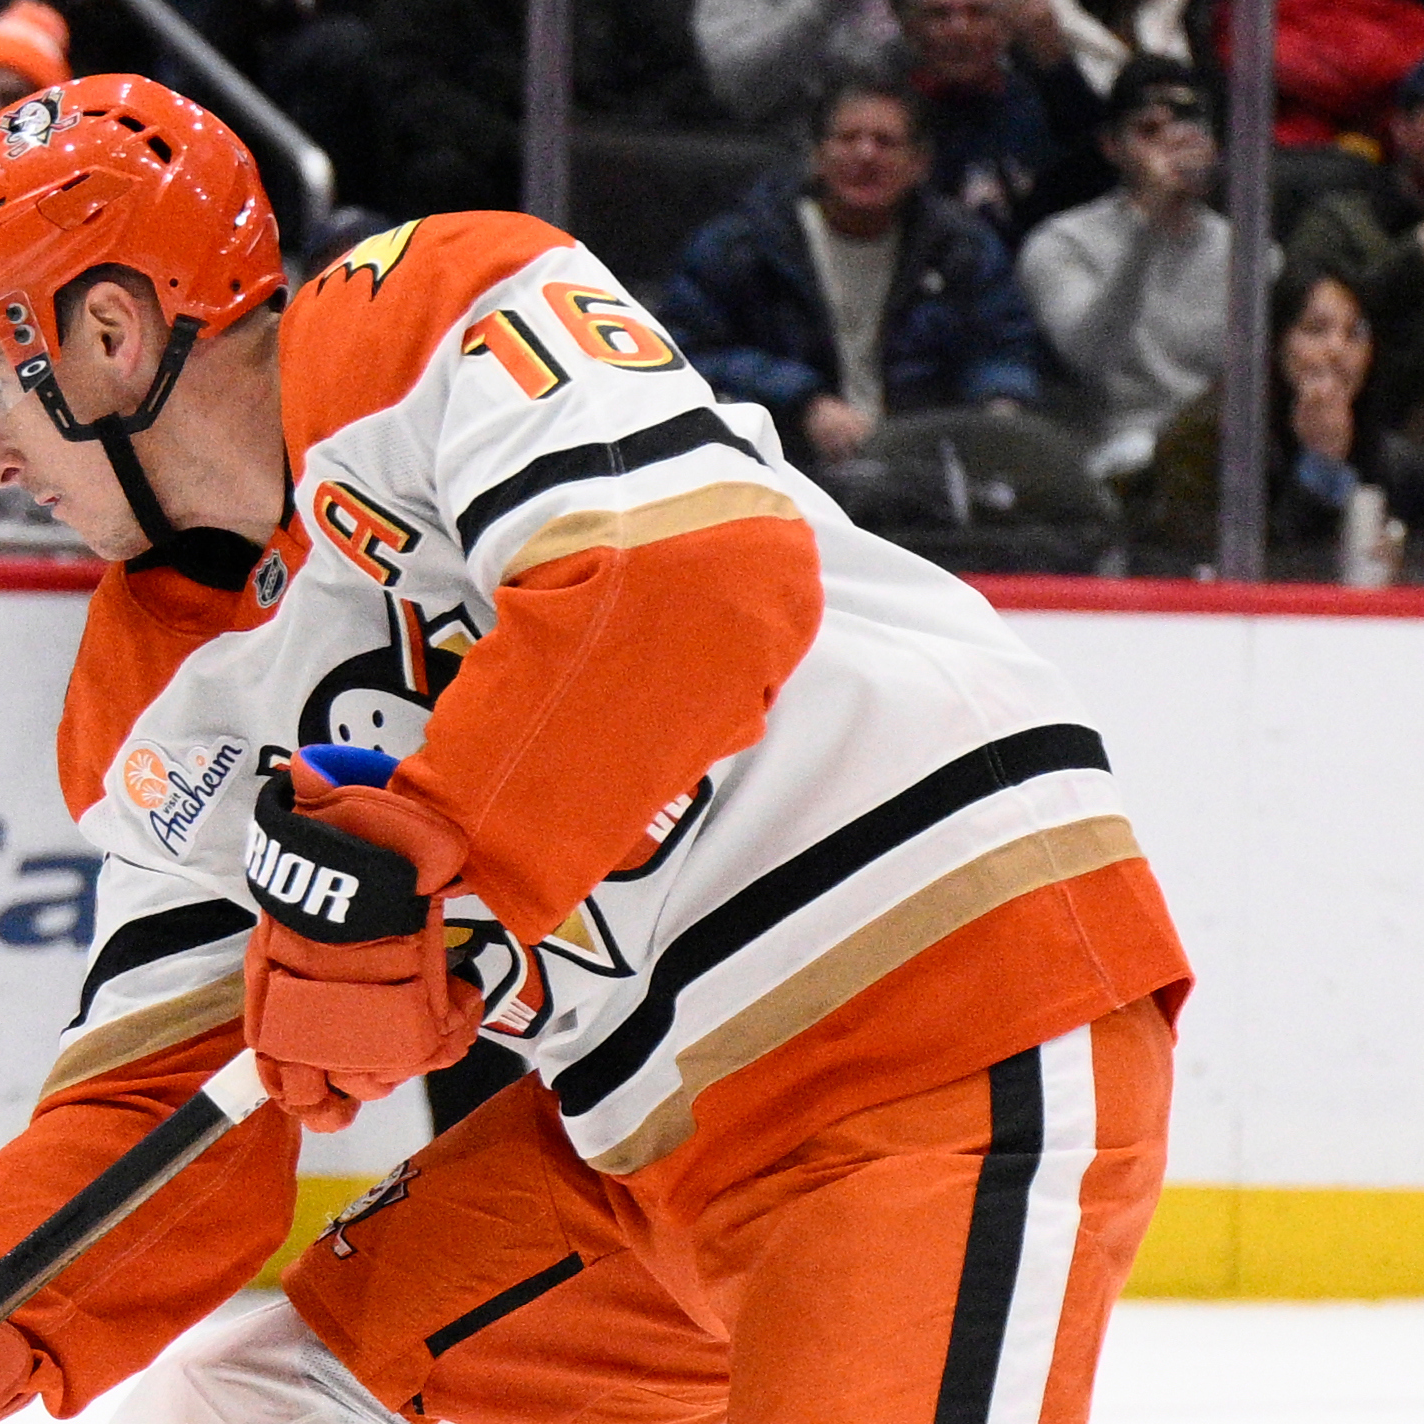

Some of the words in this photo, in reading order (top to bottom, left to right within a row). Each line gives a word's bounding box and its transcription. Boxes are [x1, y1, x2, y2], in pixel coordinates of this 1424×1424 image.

[461, 282, 686, 400] 16
[313, 480, 422, 587] A
[150, 744, 243, 856] Anaheim
[163, 792, 181, 815] visit
[245, 819, 360, 923] RIOR
